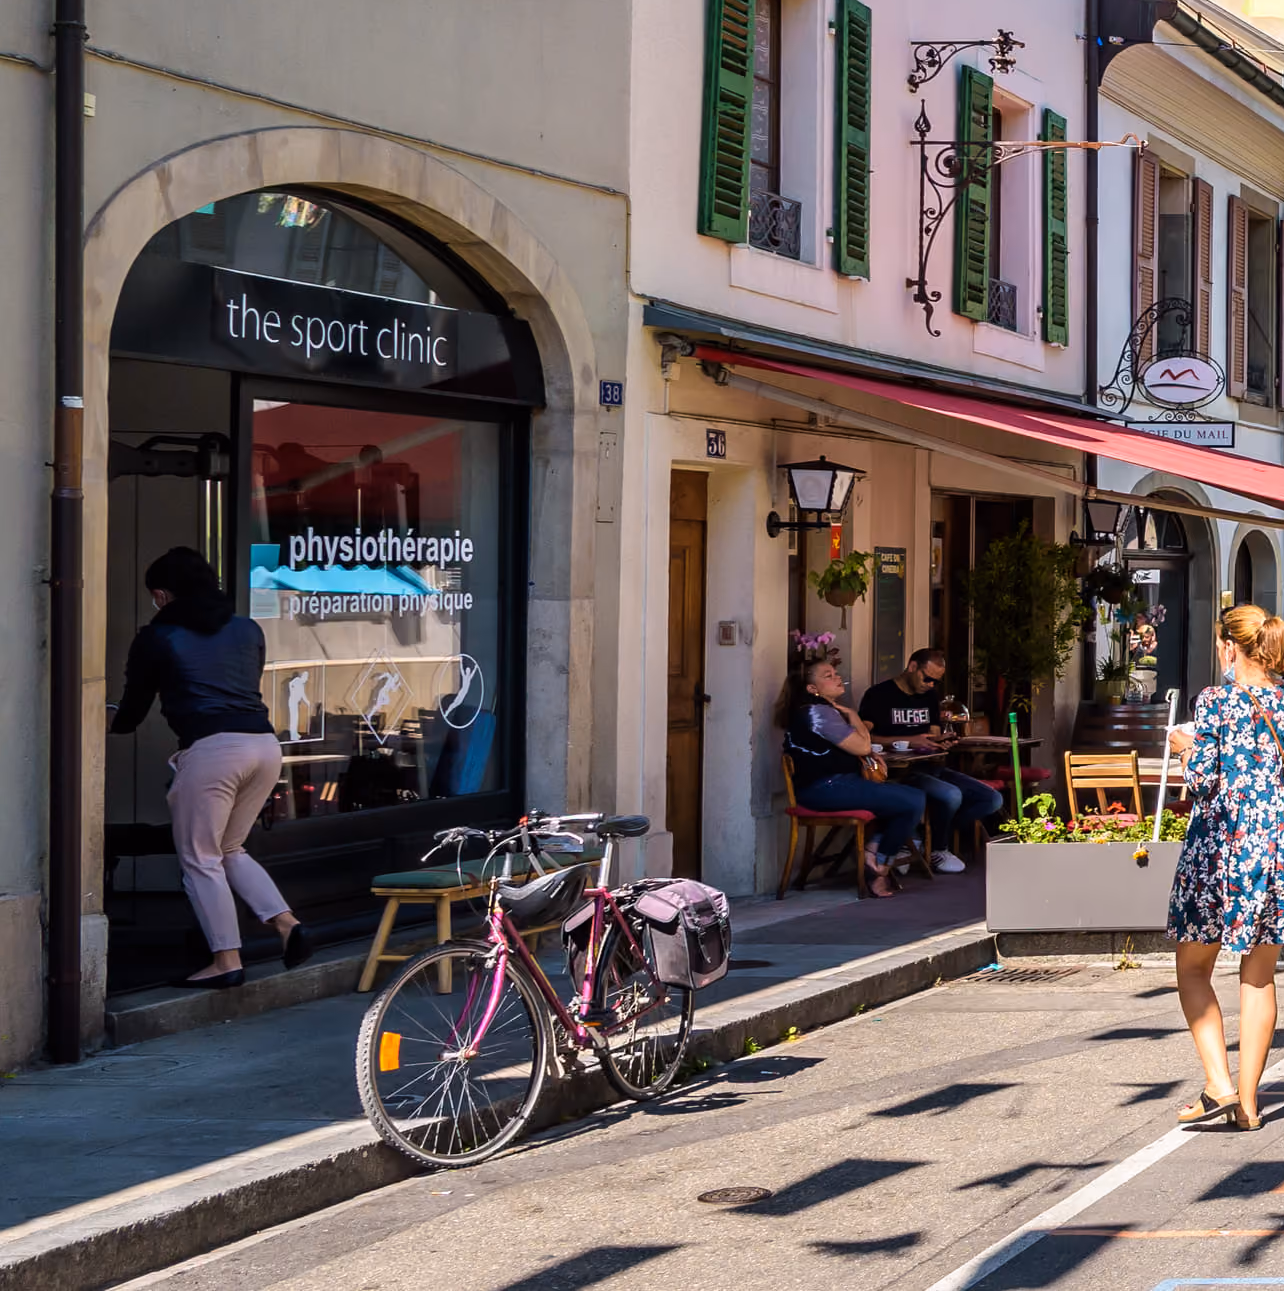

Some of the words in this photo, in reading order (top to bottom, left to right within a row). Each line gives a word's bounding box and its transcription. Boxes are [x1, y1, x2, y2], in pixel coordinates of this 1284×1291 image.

[227, 293, 280, 343] the
[291, 314, 369, 358] sport
[377, 318, 448, 366] clinic
[605, 384, 620, 402] 38
[1174, 429, 1192, 439] DU
[1196, 429, 1229, 440] MAIL
[289, 526, 474, 570] physiothérapie
[289, 591, 393, 620] préparation
[399, 592, 473, 618] physique
